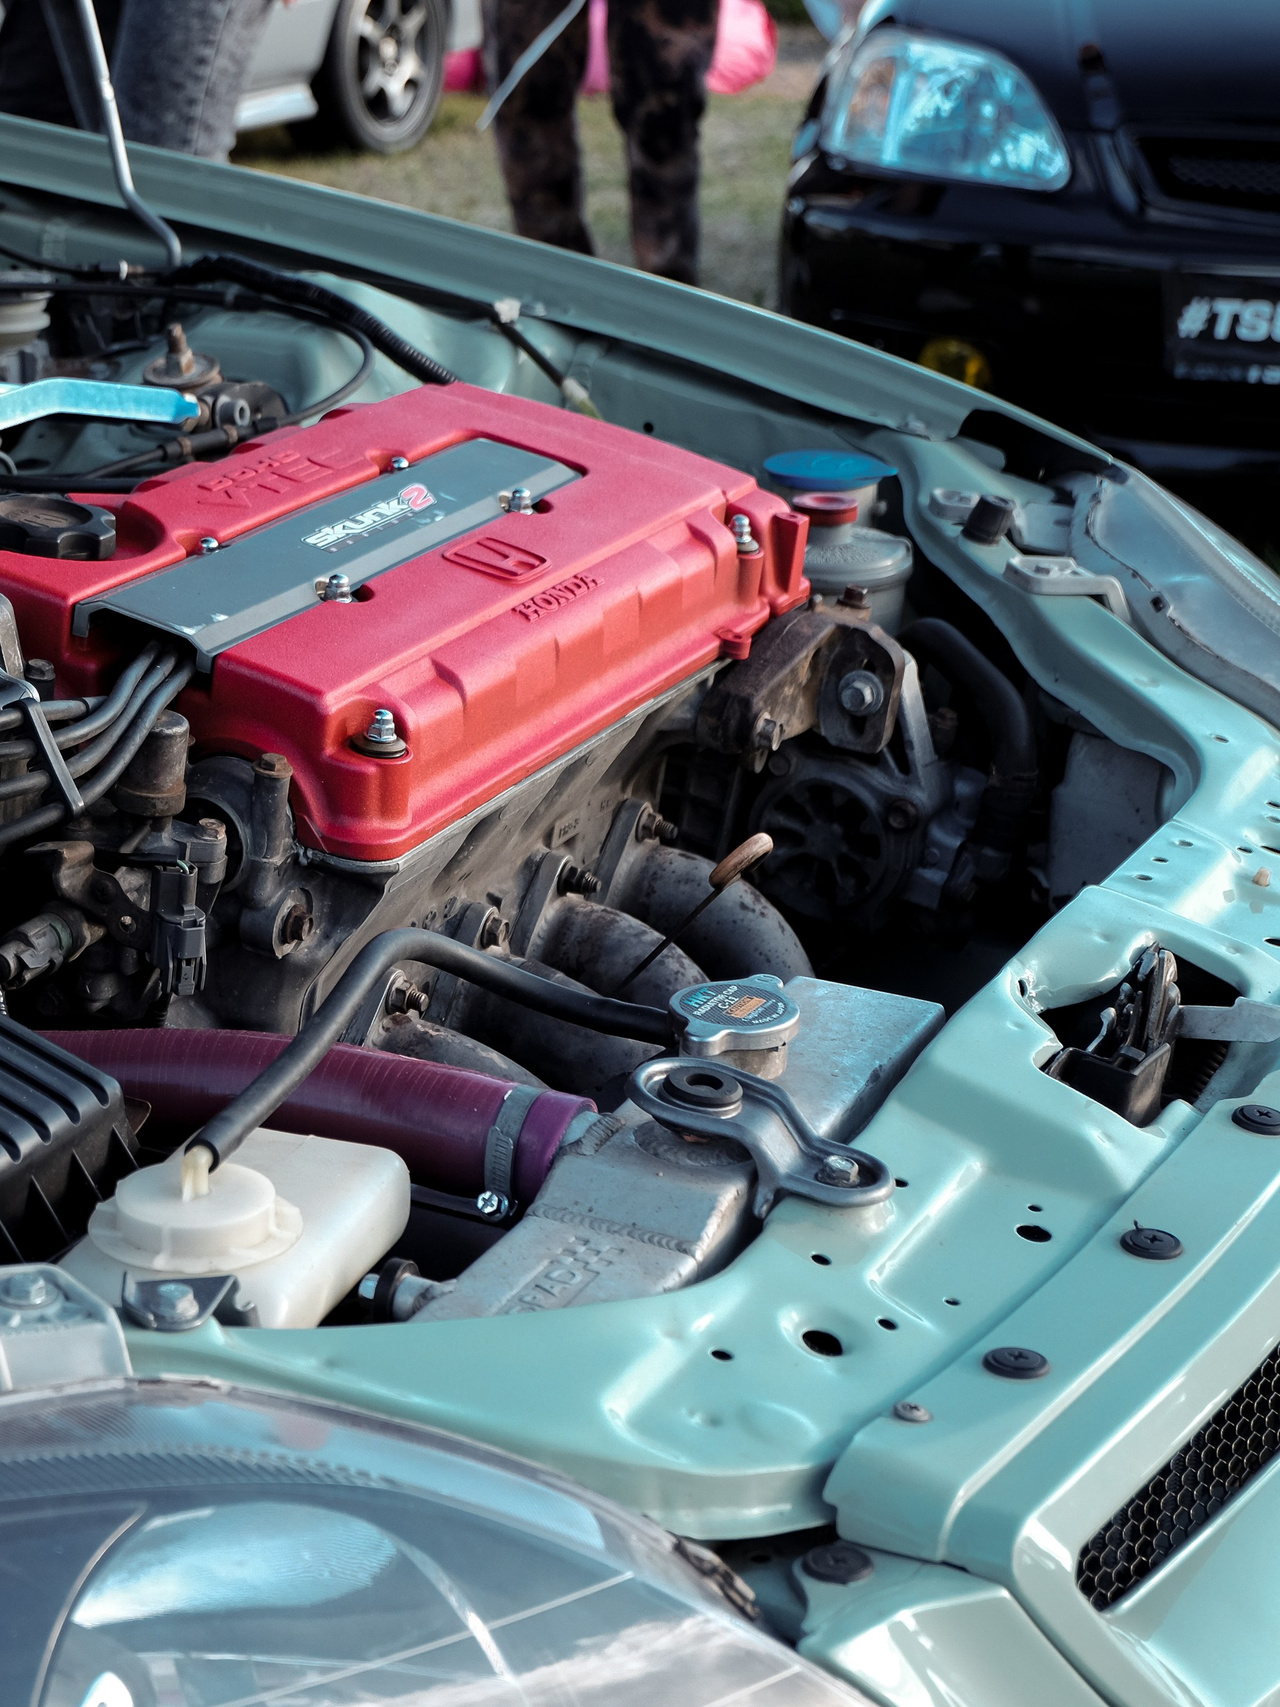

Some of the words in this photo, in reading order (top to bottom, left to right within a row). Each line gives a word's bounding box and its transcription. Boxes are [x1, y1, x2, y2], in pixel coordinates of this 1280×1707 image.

[197, 450, 365, 508] VTEC
[511, 573, 605, 623] HONDA
[684, 987, 716, 1008] HKT
